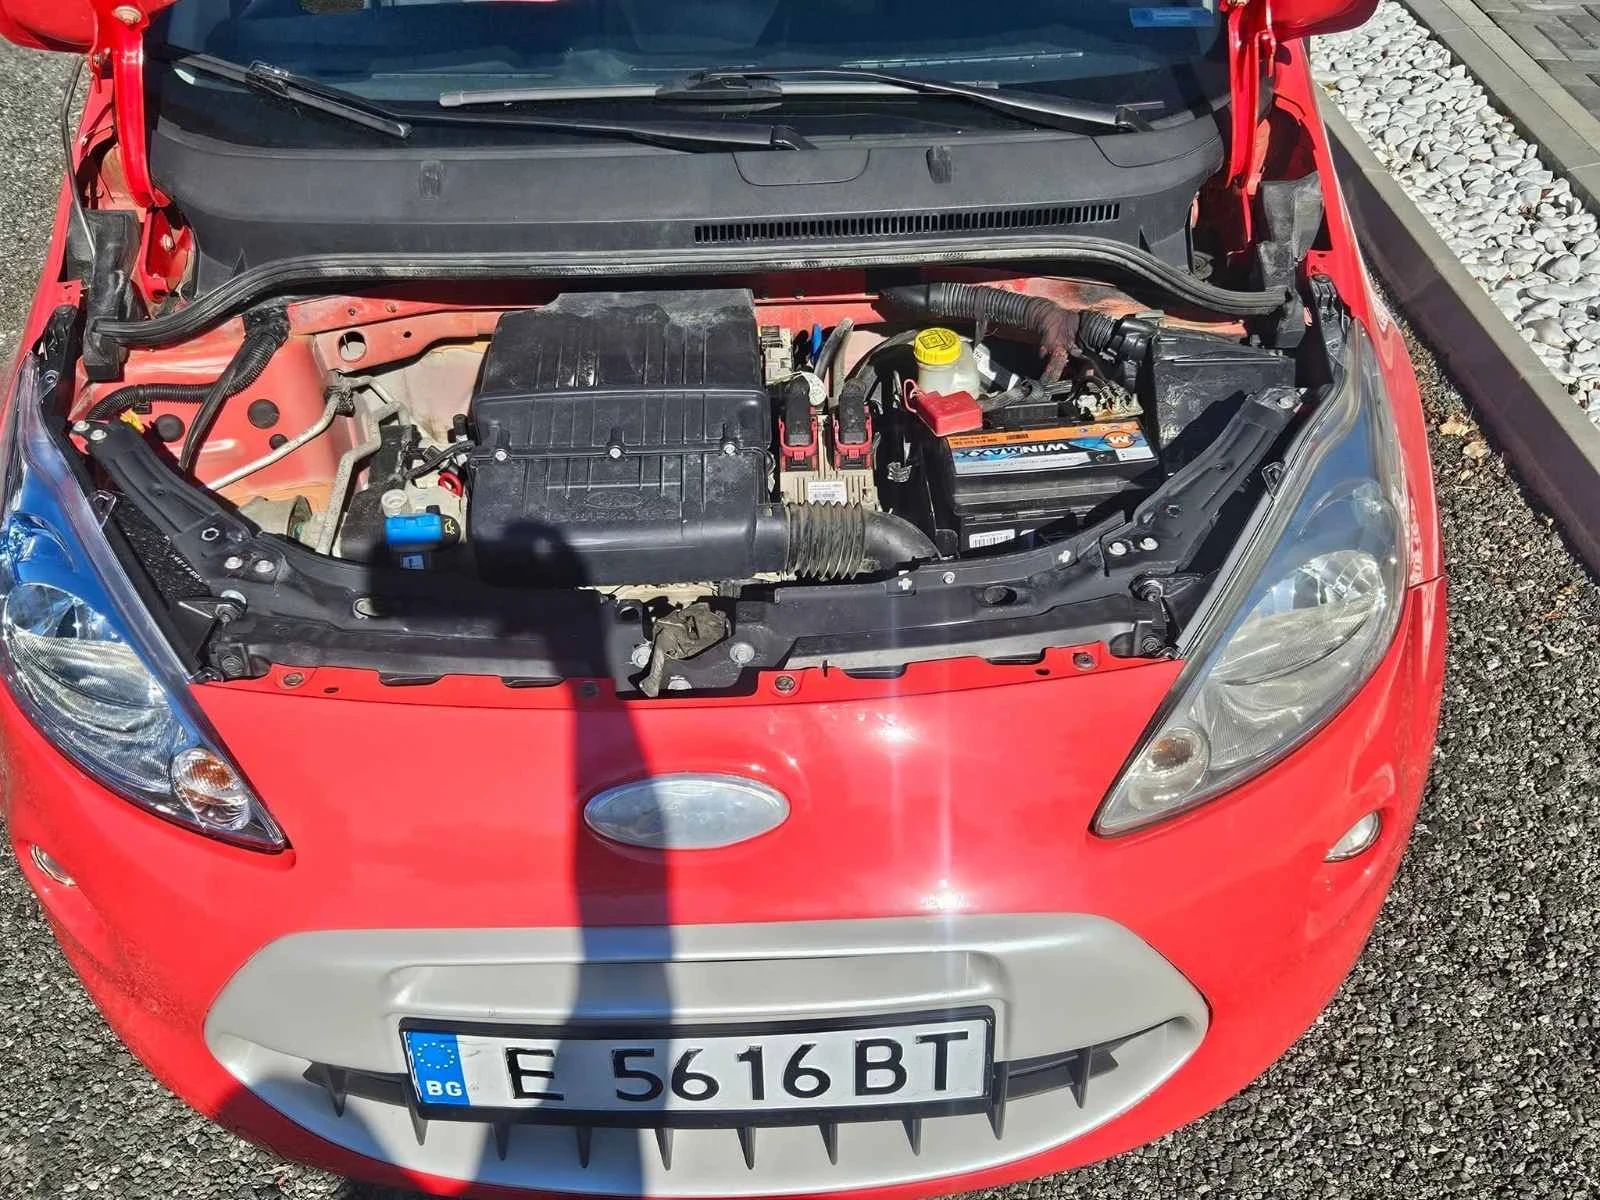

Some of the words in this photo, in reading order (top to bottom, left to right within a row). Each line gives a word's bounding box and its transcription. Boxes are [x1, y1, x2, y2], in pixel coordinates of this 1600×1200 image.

[504, 1046, 565, 1101] E
[611, 1042, 832, 1102] 5616
[854, 1030, 969, 1097] BT
[425, 1080, 463, 1097] BG
